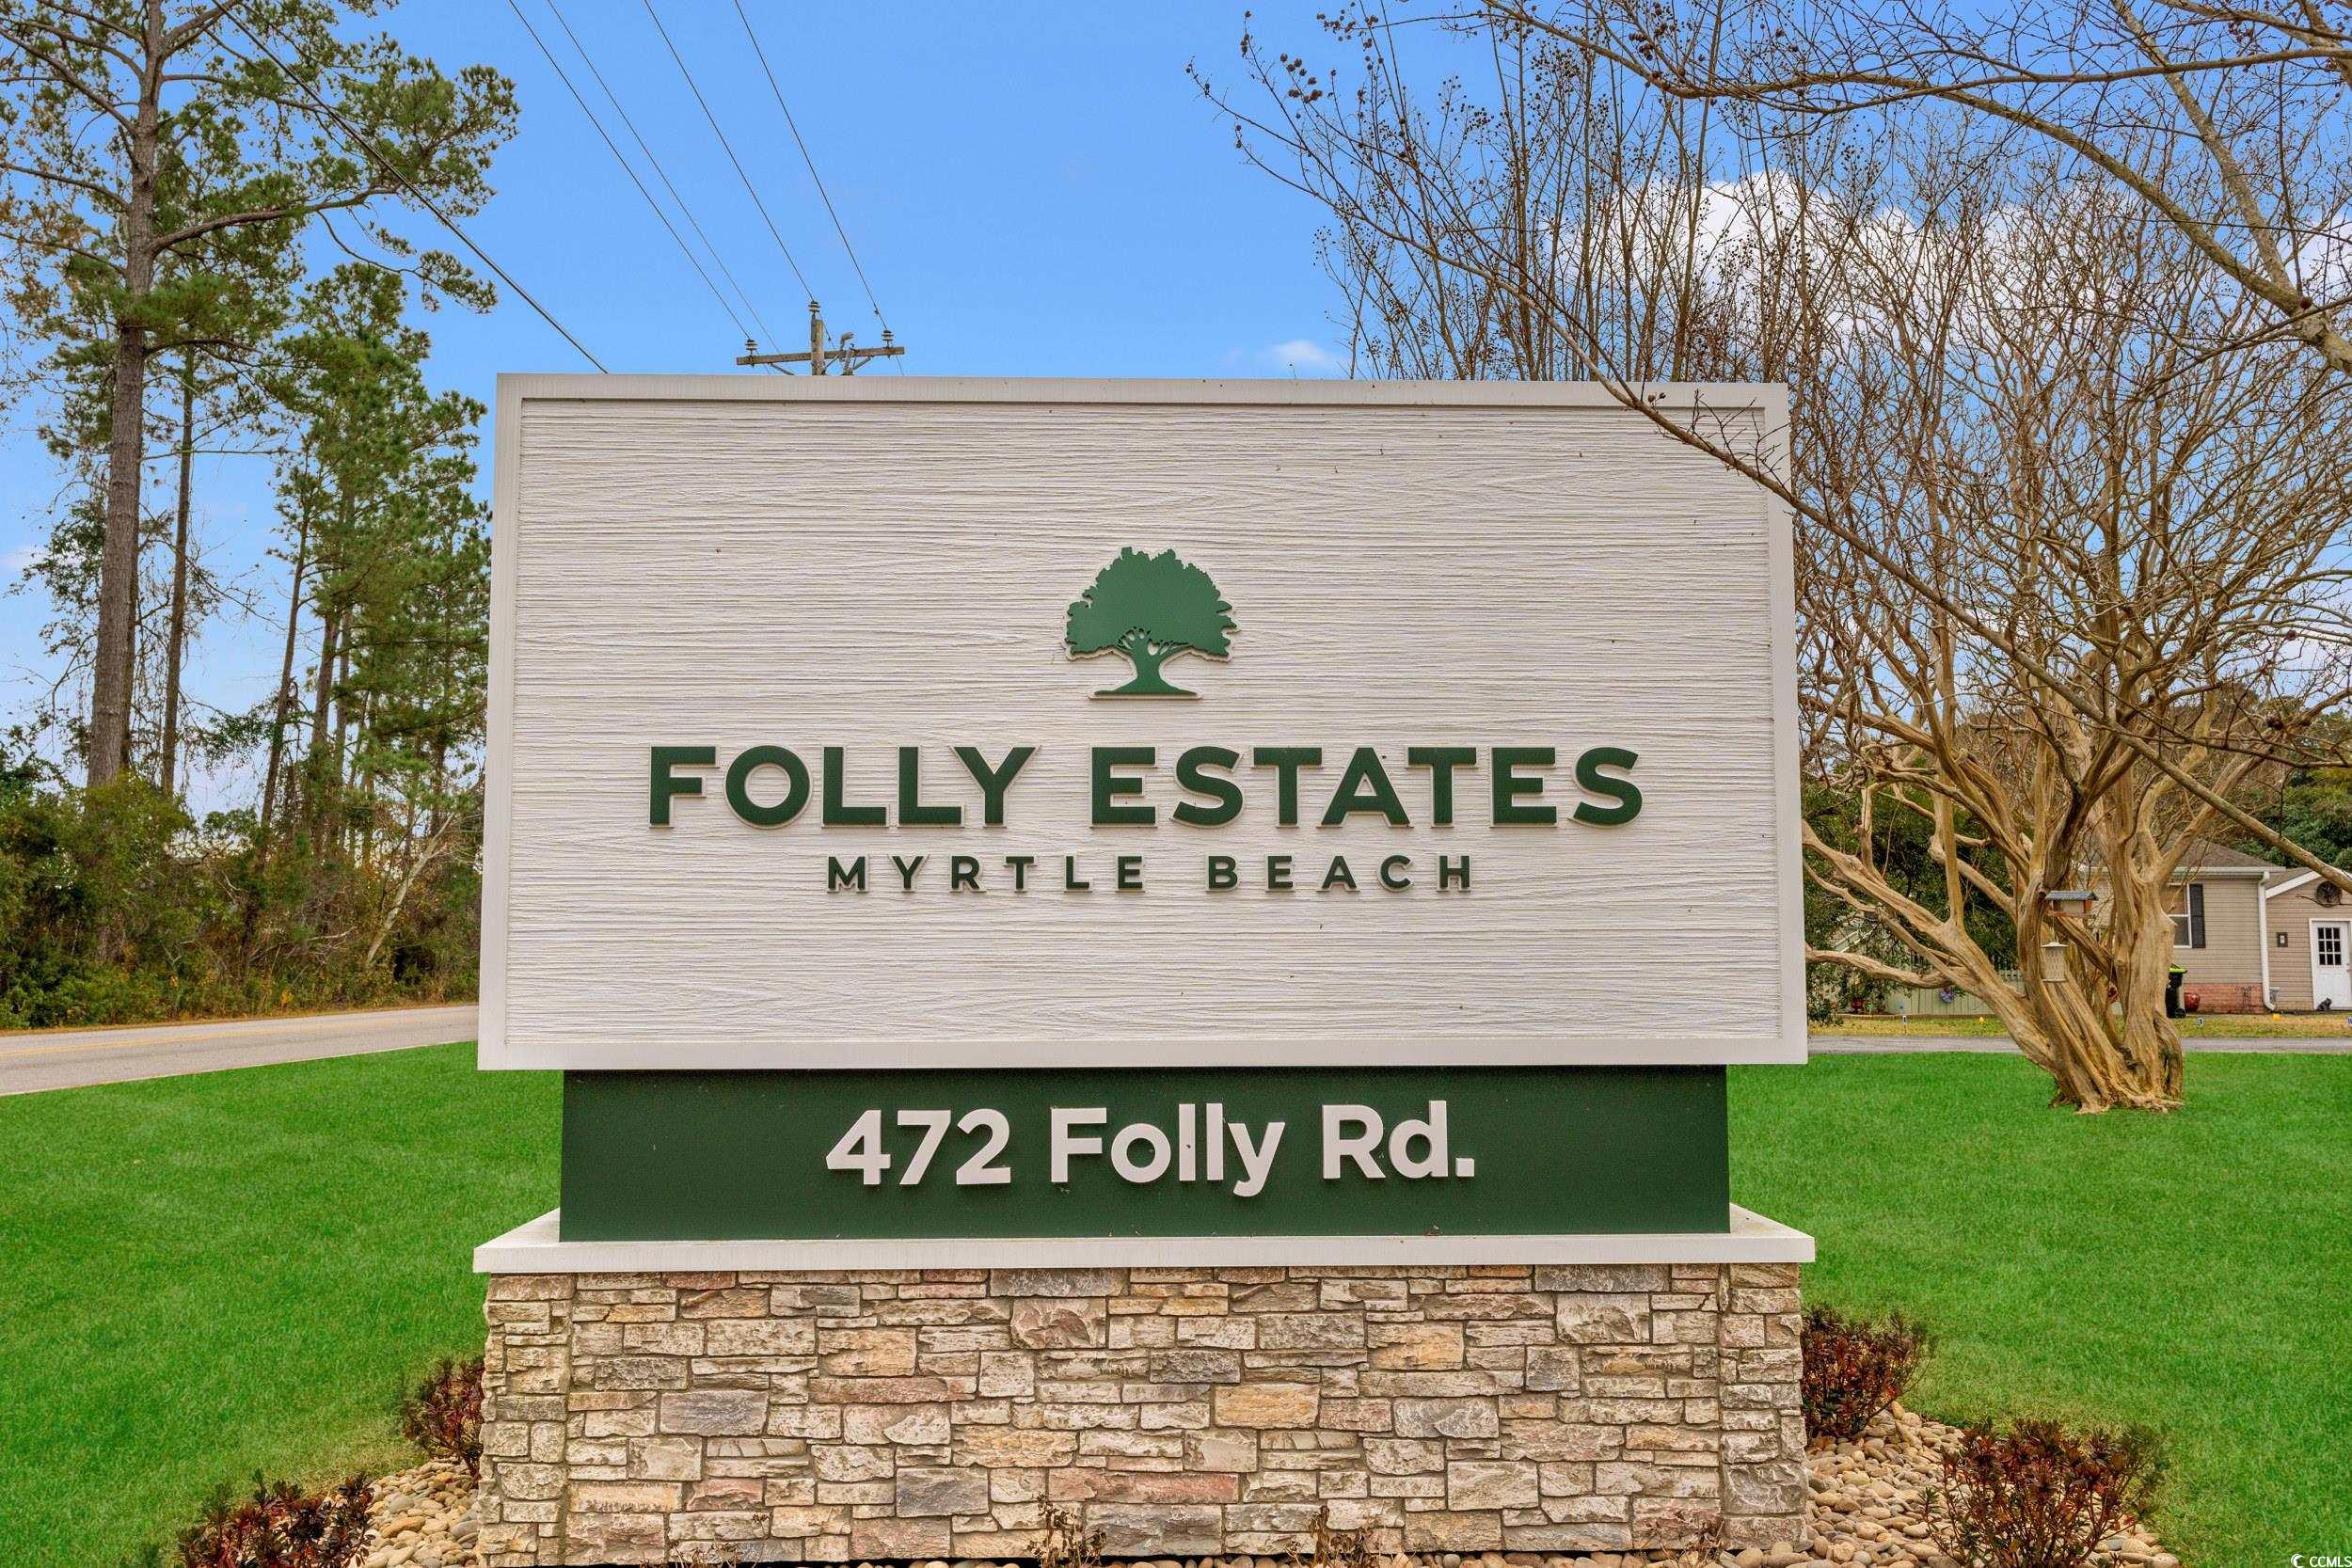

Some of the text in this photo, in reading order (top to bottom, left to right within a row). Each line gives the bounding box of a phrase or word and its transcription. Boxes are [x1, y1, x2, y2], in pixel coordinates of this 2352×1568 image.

[650, 745, 1643, 828] FOLLY ESTATES
[828, 855, 1470, 890] MYRTLE BEACH
[826, 1101, 1475, 1197] 472 Folly Rd.
